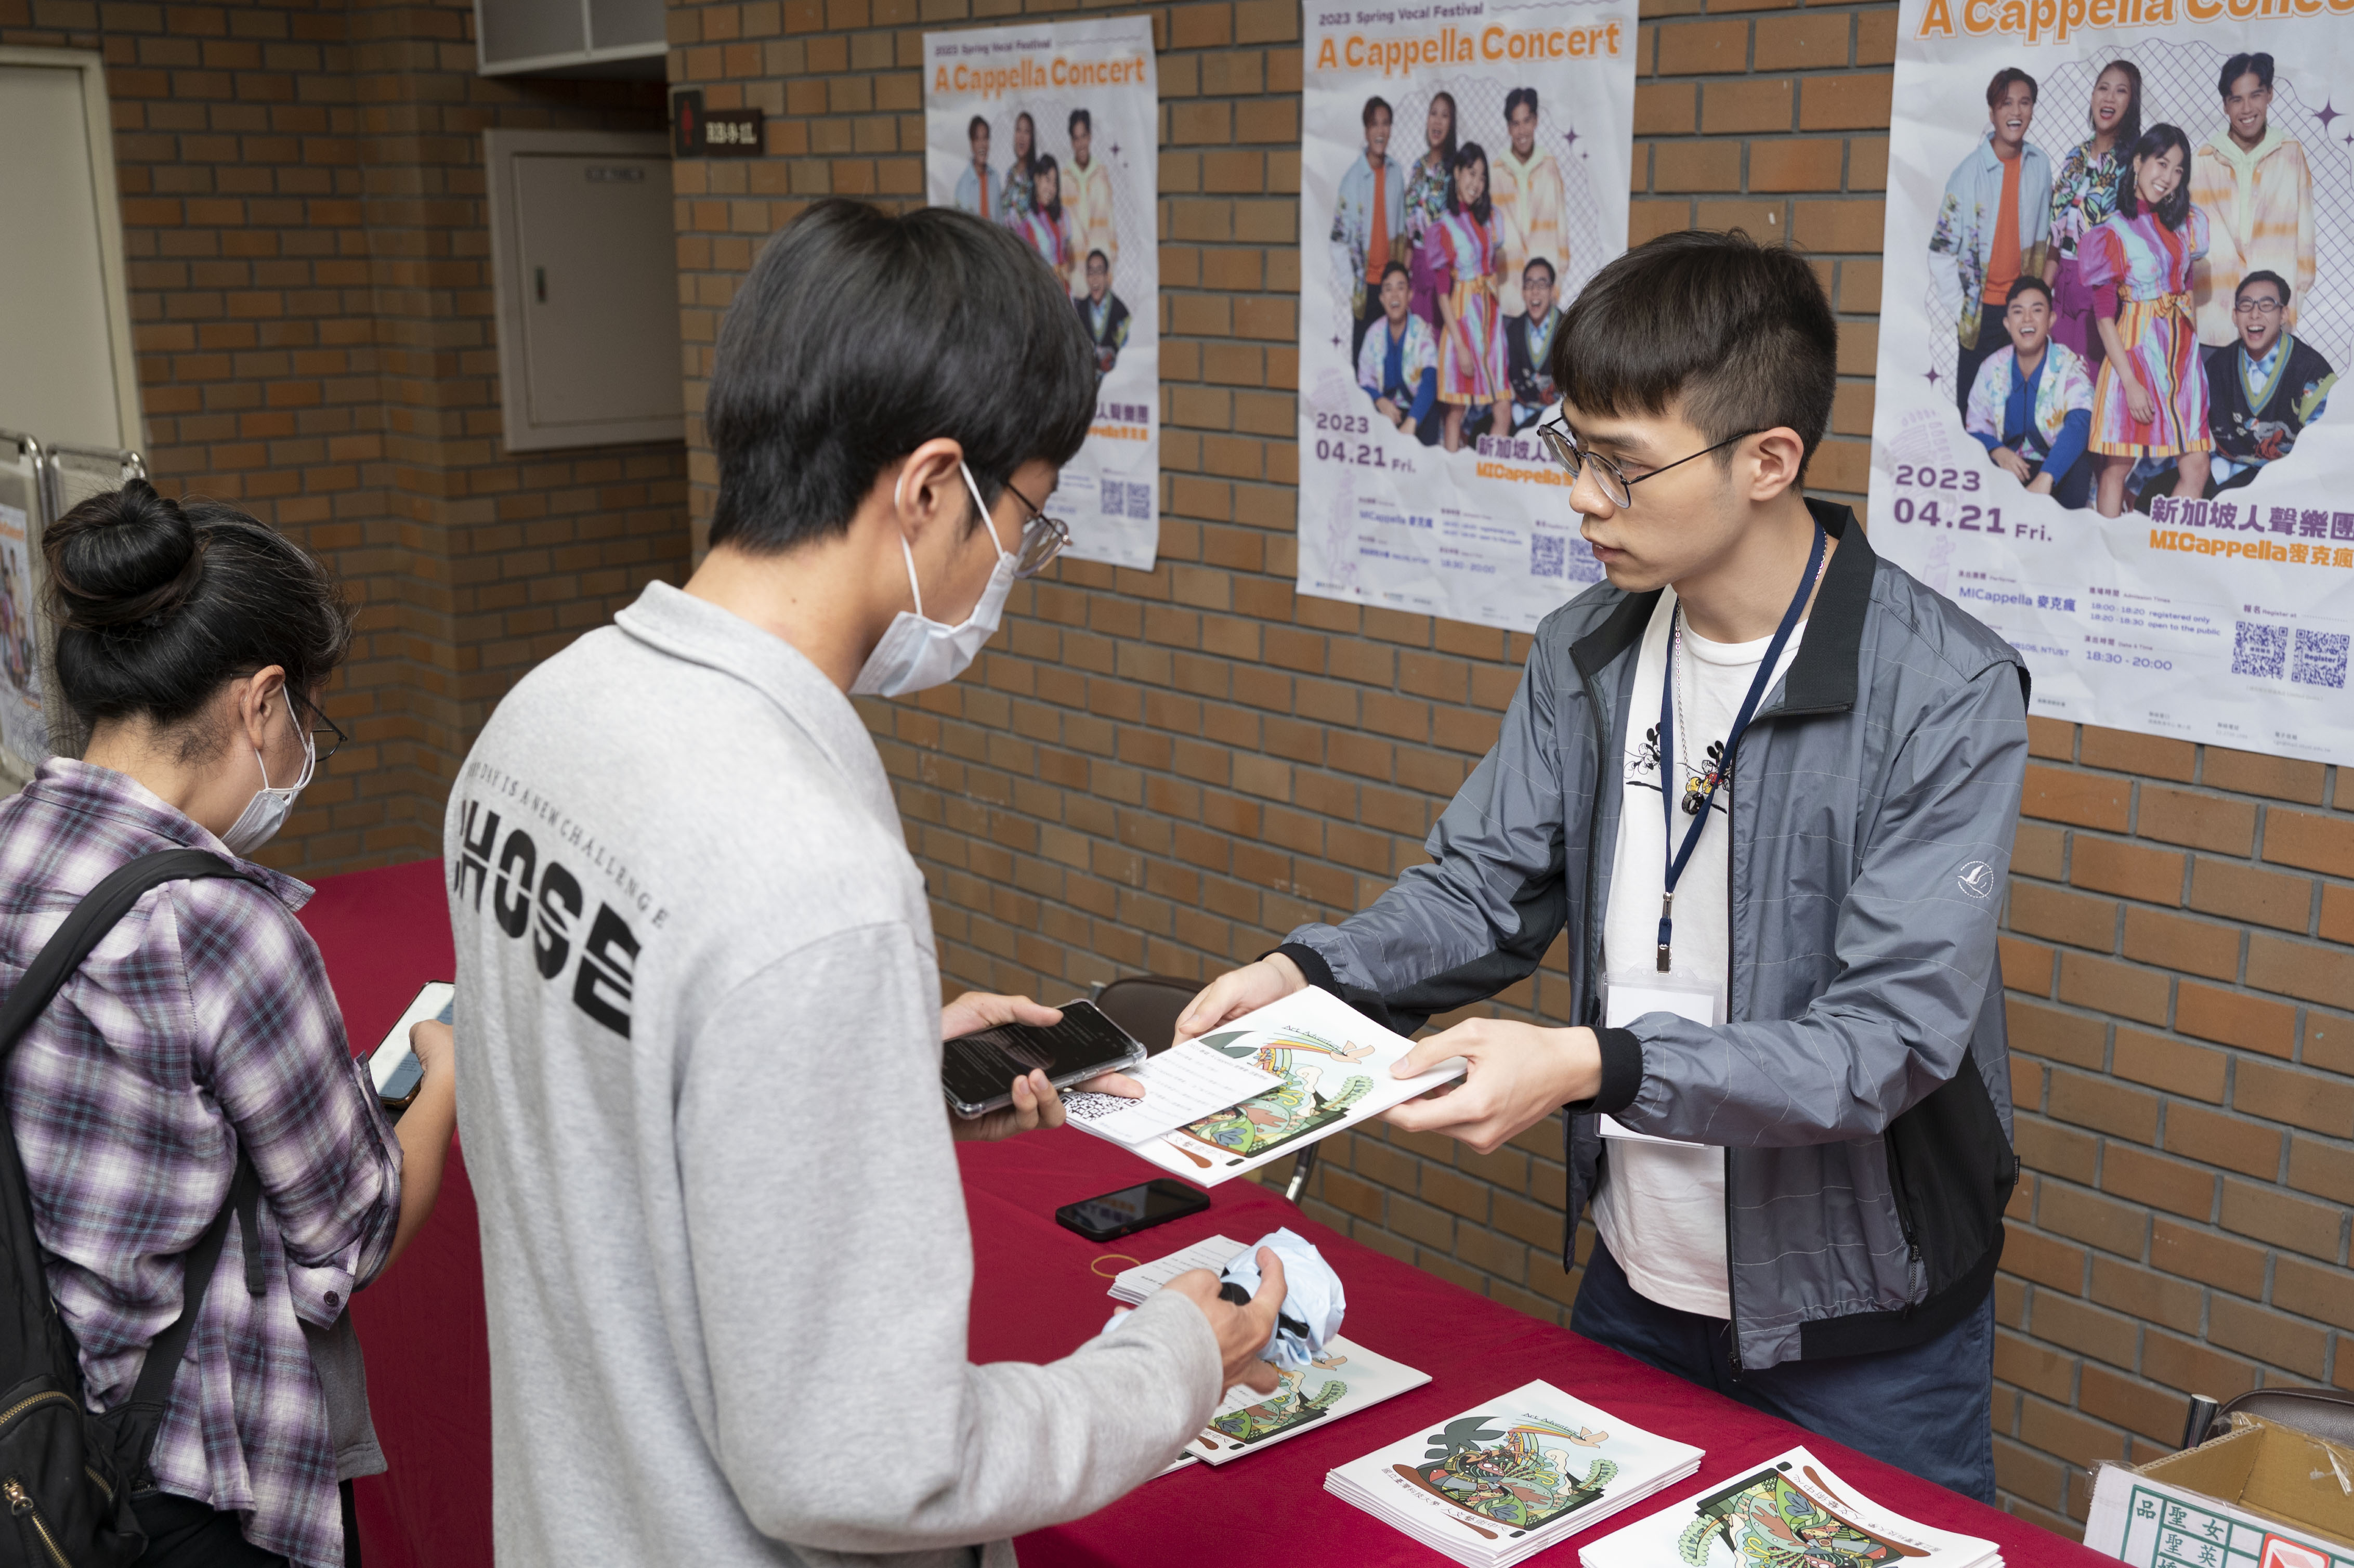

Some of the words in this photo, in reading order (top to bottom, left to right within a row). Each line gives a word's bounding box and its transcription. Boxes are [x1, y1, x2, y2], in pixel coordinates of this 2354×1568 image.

[1318, 12, 1351, 26] 2023
[1356, 10, 1395, 24] Spring
[1398, 7, 1430, 20] Vocal
[1434, 2, 1484, 18] Festival
[1317, 37, 1338, 69] A
[1344, 28, 1474, 76] Cappella
[1481, 22, 1620, 60] Concert
[935, 66, 950, 92] A
[953, 58, 1046, 99] Cappella
[1051, 56, 1145, 85] Concert
[1317, 413, 1369, 434] 2023
[1316, 439, 1387, 467] 04.21
[1392, 458, 1417, 473] Fri.
[1479, 436, 1557, 464] 新加坡人
[1895, 464, 1980, 492] 2023
[1894, 498, 2006, 534] 04.21
[2015, 523, 2052, 542] Fri.
[2151, 496, 2354, 542] 新加坡人聲樂團
[1959, 586, 2033, 606] MICappella
[2120, 617, 2144, 626] 18:30
[2196, 626, 2221, 636] public
[2122, 606, 2145, 616] 18:20
[2149, 610, 2191, 622] registered
[2193, 615, 2211, 624] only
[2086, 650, 2123, 664] 18:30
[2132, 656, 2173, 671] 20:00
[2304, 653, 2336, 663] Register
[559, 818, 669, 930] CHALLENGE
[454, 799, 642, 1041] HOSE
[1522, 1412, 1539, 1420] Art
[1540, 1418, 1579, 1435] Adventure
[2136, 1499, 2156, 1520] 品
